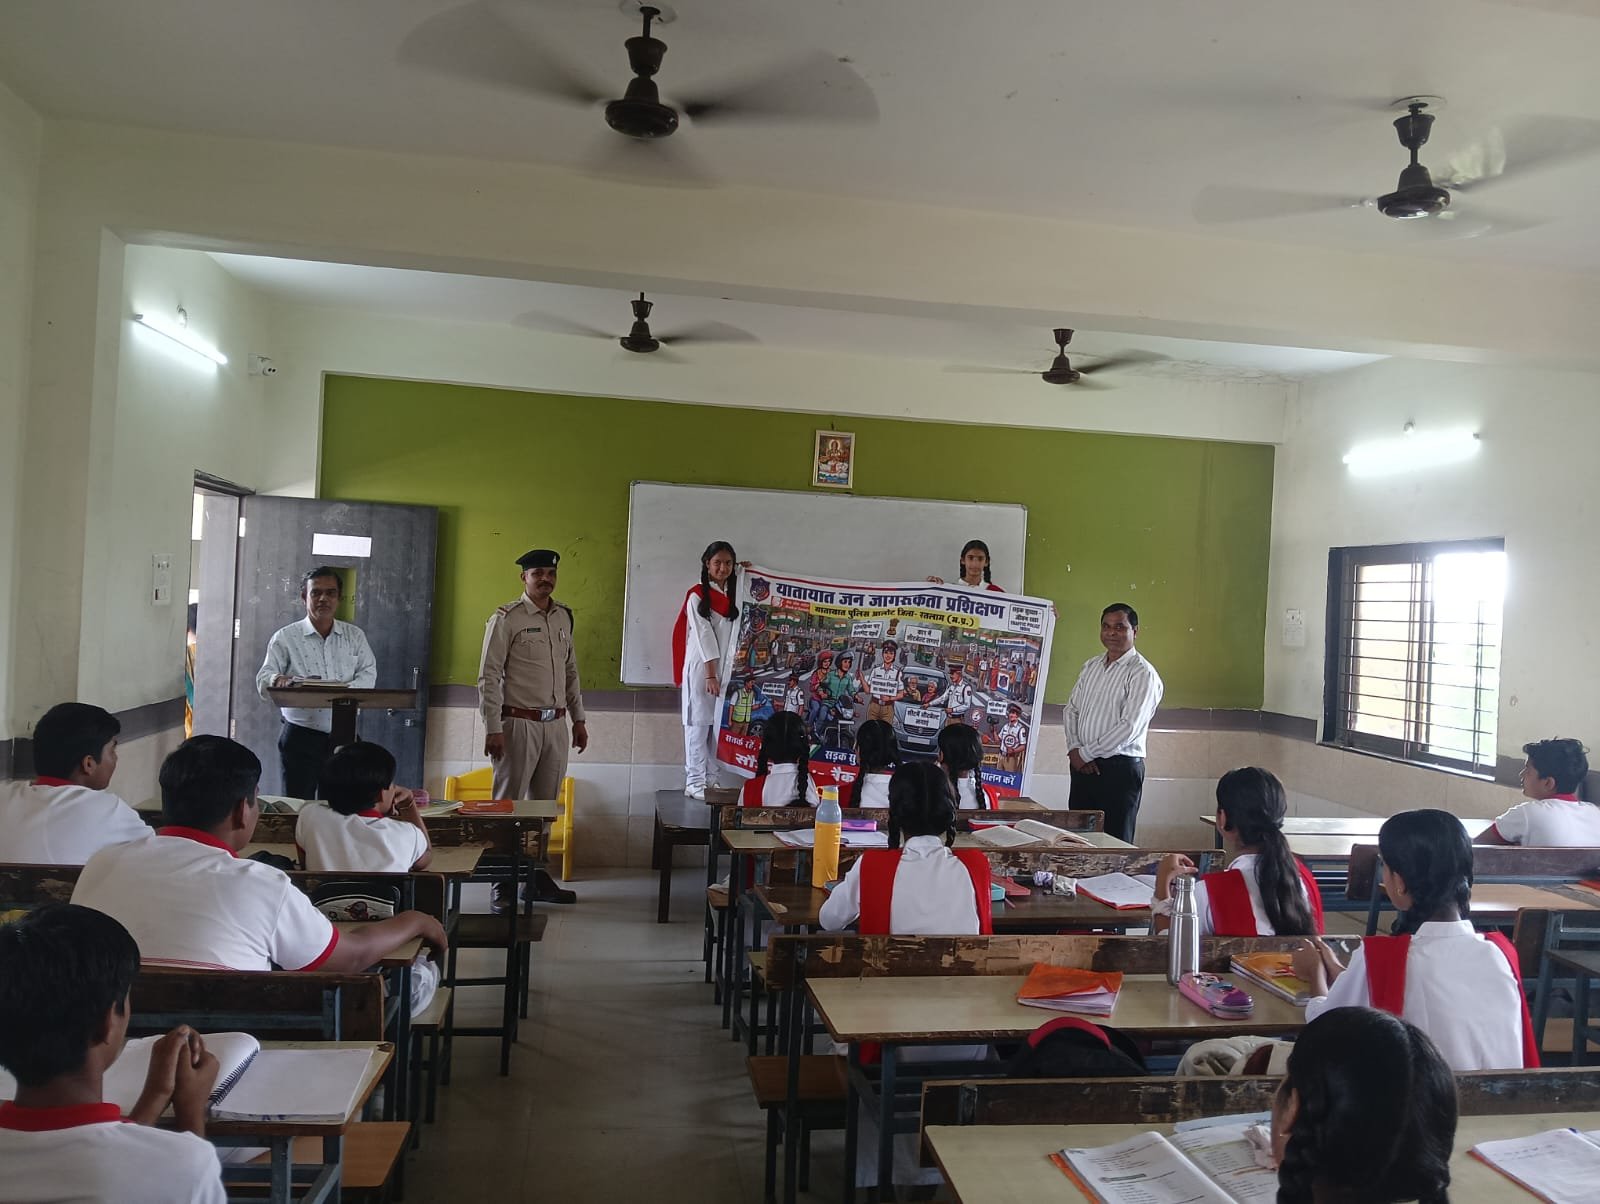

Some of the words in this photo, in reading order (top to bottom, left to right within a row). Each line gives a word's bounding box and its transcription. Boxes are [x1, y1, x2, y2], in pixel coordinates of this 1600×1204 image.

[775, 583, 836, 605] यातायात
[838, 592, 866, 607] जन
[945, 595, 1006, 619] प्रशिक्षण
[814, 606, 846, 616] यातायात
[847, 606, 870, 619] पुलिस
[919, 611, 945, 621] रतलाम
[725, 734, 744, 746] सतर्क
[825, 750, 848, 763] सड़क
[1003, 774, 1016, 785] करें
